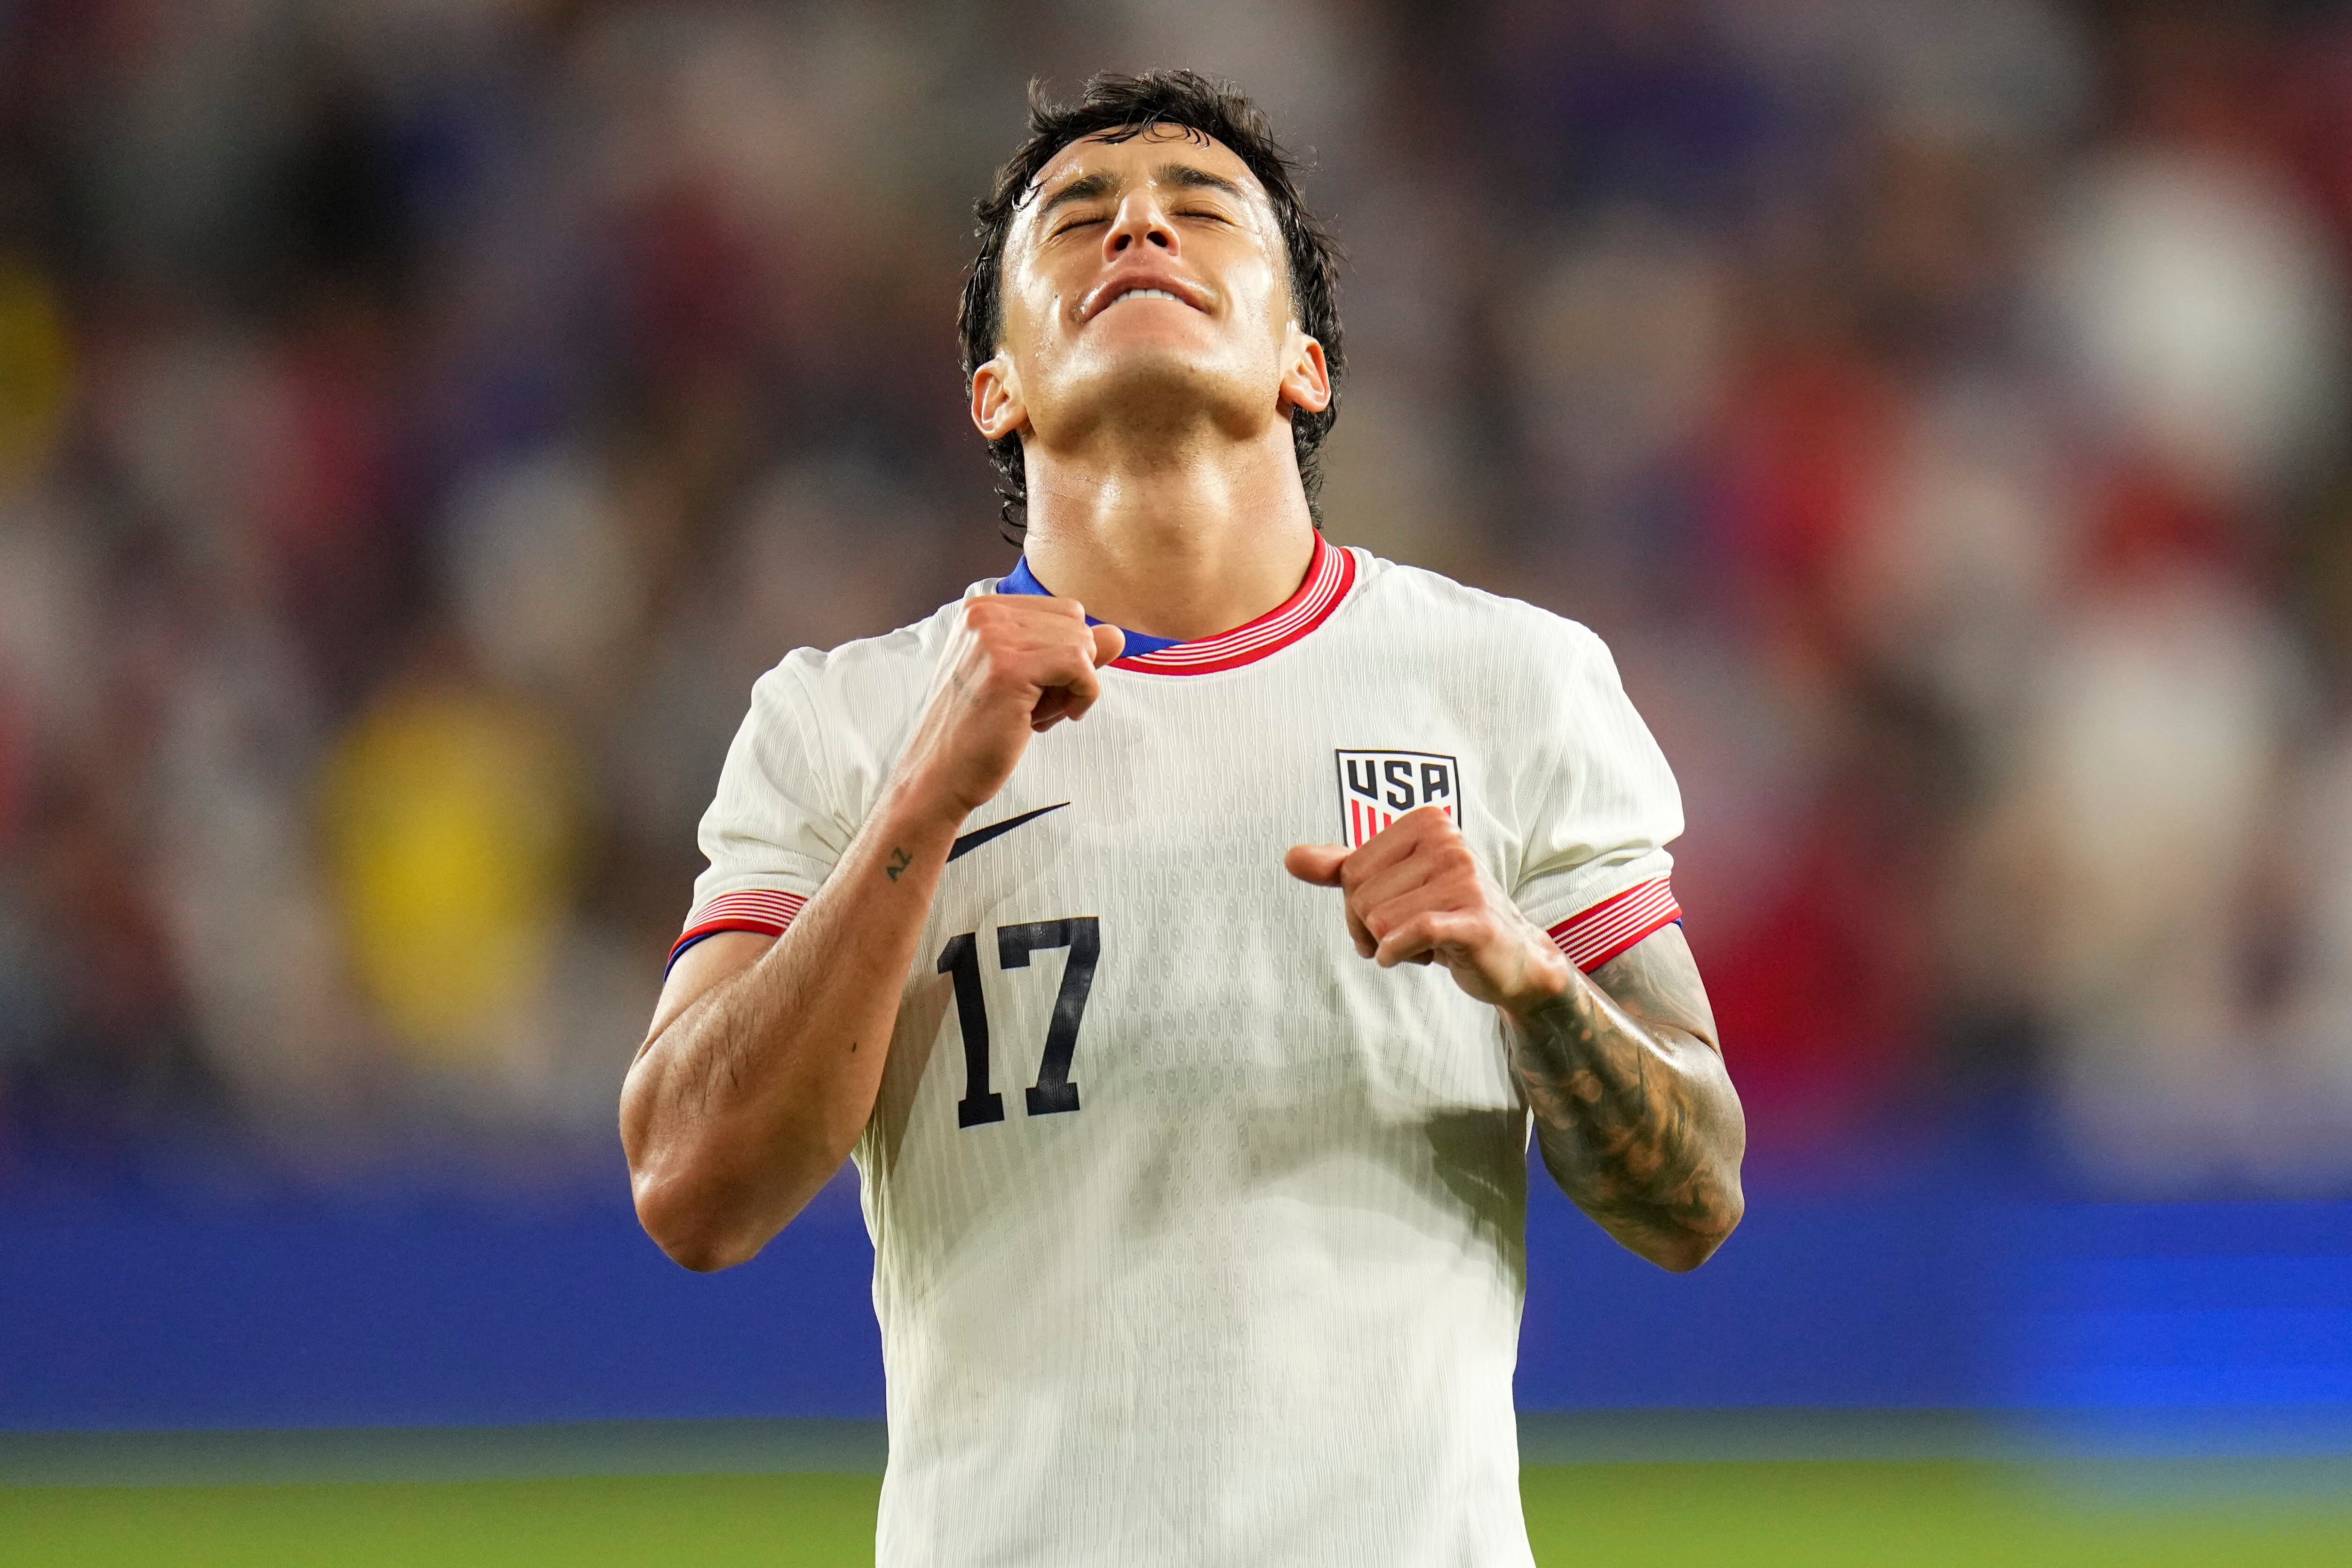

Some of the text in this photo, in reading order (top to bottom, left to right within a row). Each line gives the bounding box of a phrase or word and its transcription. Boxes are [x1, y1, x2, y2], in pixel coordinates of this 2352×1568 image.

[1347, 760, 1450, 811] USA
[886, 847, 914, 882] AZ
[937, 916, 1100, 1128] 17
